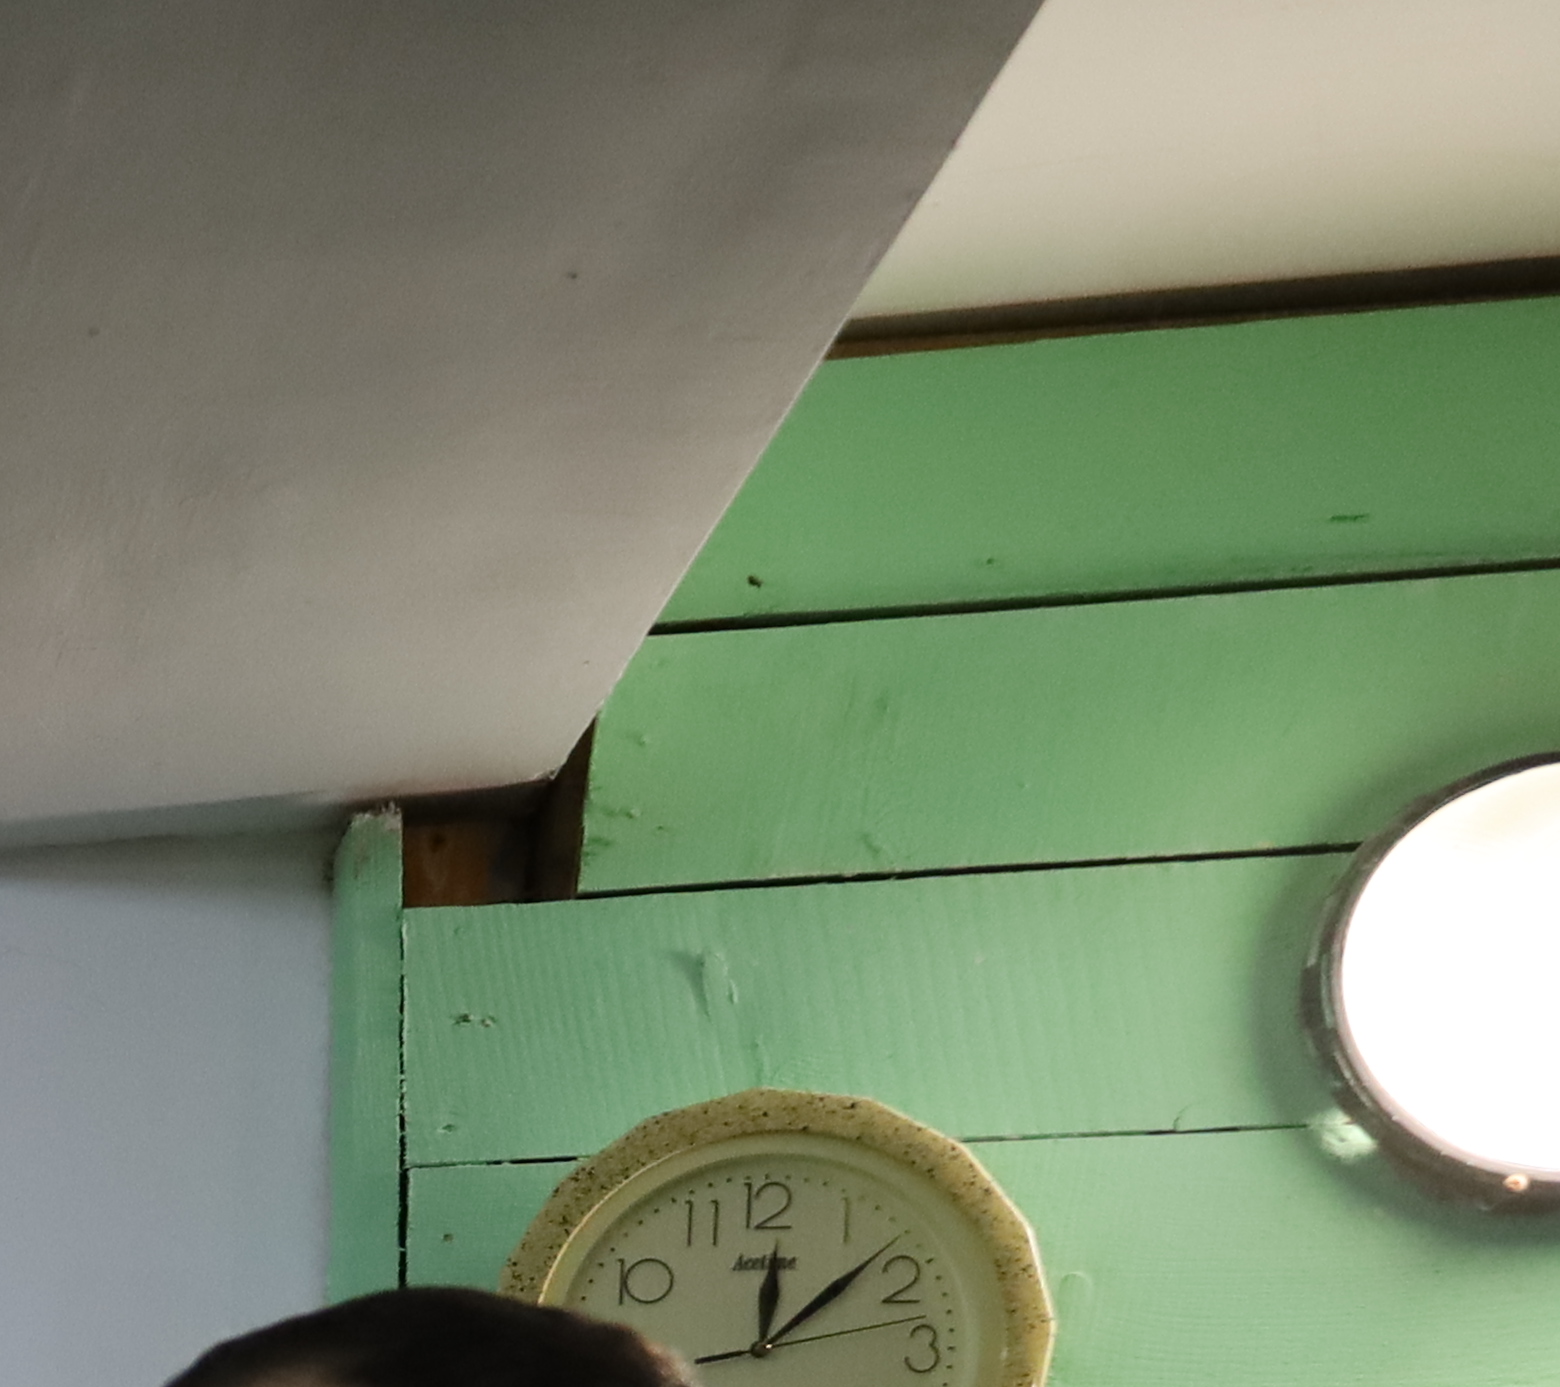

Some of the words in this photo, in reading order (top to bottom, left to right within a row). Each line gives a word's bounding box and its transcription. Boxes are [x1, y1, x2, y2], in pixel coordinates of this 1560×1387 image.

[686, 1198, 721, 1247] 11
[744, 1181, 792, 1231] 12
[842, 1196, 852, 1245] 1
[618, 1257, 674, 1306] 10
[730, 1252, 797, 1271] Acetme
[882, 1254, 922, 1304] 2
[904, 1323, 941, 1374] 3
